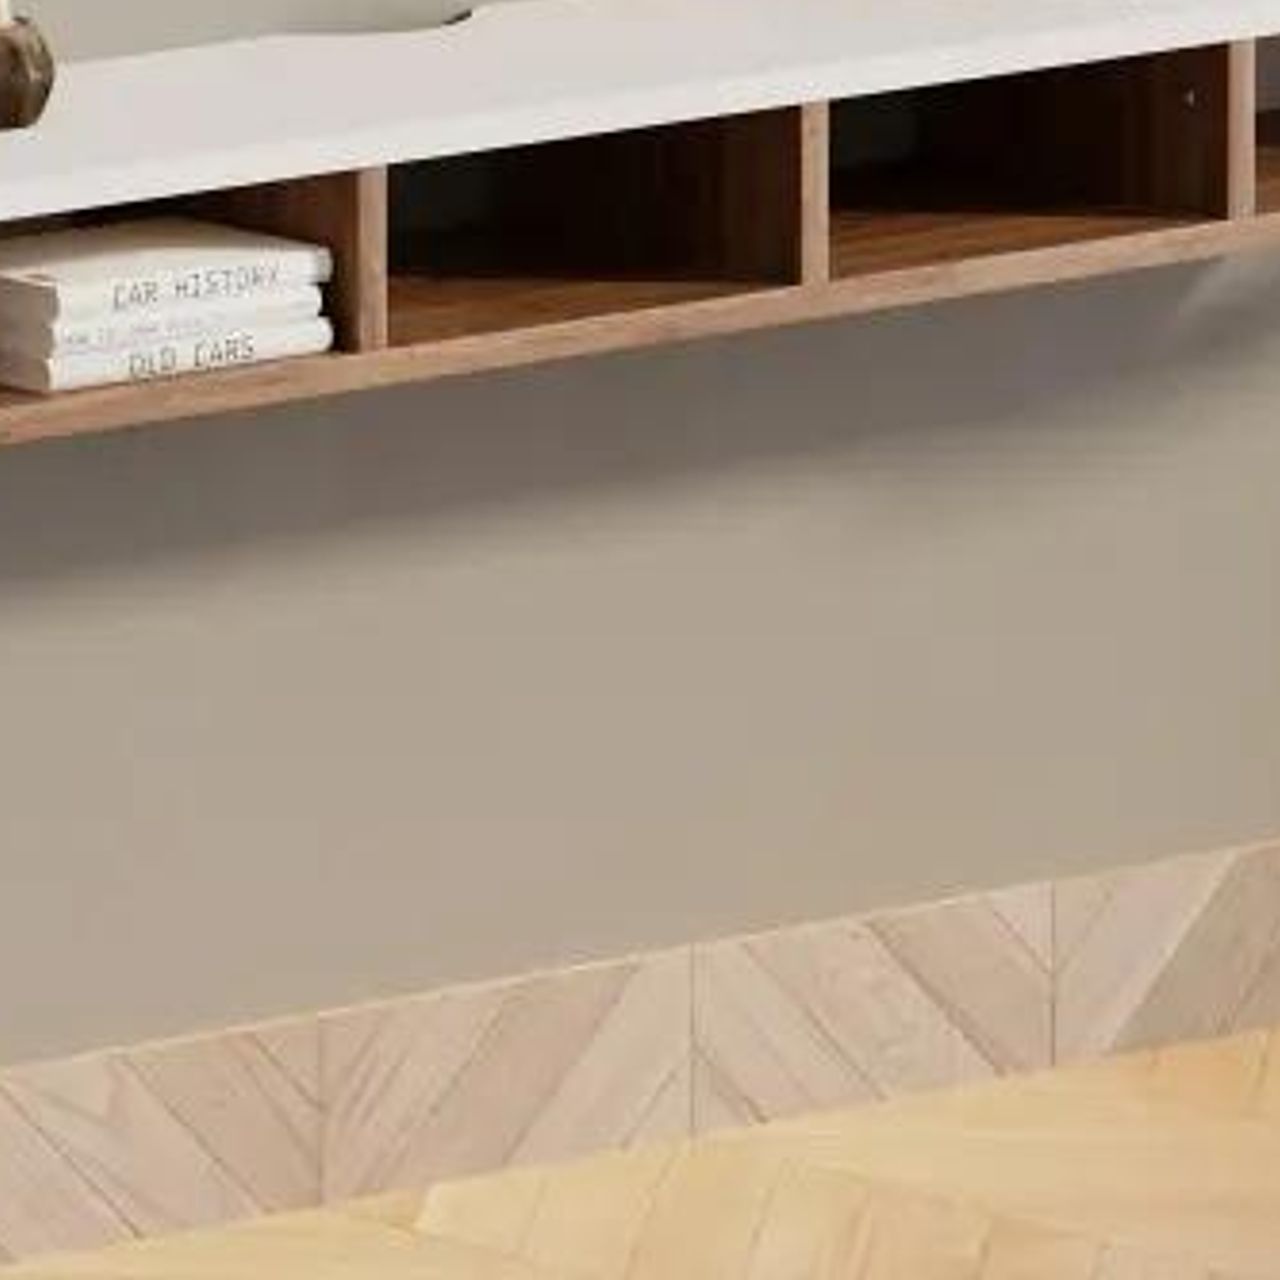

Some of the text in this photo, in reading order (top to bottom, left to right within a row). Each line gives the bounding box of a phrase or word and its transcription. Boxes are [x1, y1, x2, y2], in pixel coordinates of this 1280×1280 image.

[113, 263, 280, 311] CAR HISTORY
[194, 333, 255, 367] CARS
